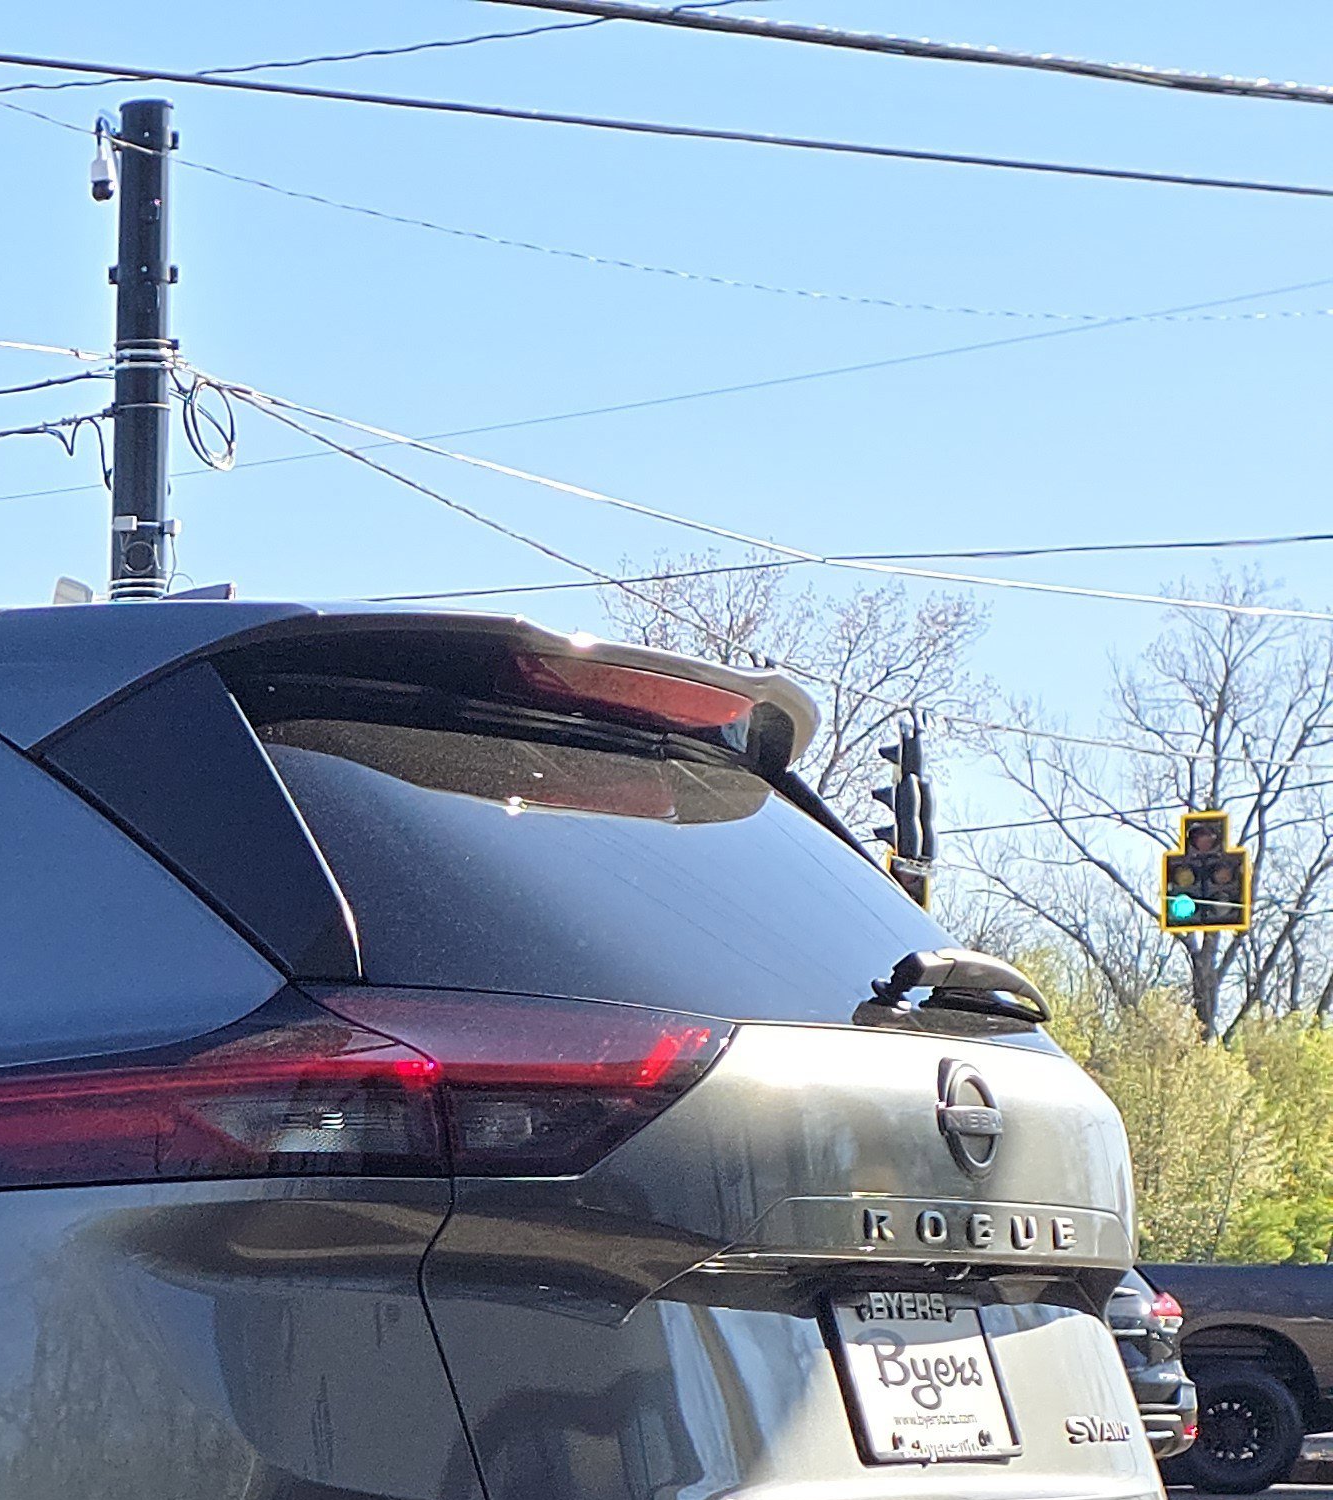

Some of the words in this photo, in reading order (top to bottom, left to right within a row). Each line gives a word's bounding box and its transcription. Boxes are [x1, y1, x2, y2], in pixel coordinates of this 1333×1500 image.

[864, 1208, 1077, 1250] ROGUE
[869, 1292, 946, 1320] BYERS
[855, 1328, 983, 1410] Byers
[1066, 1415, 1101, 1444] SV
